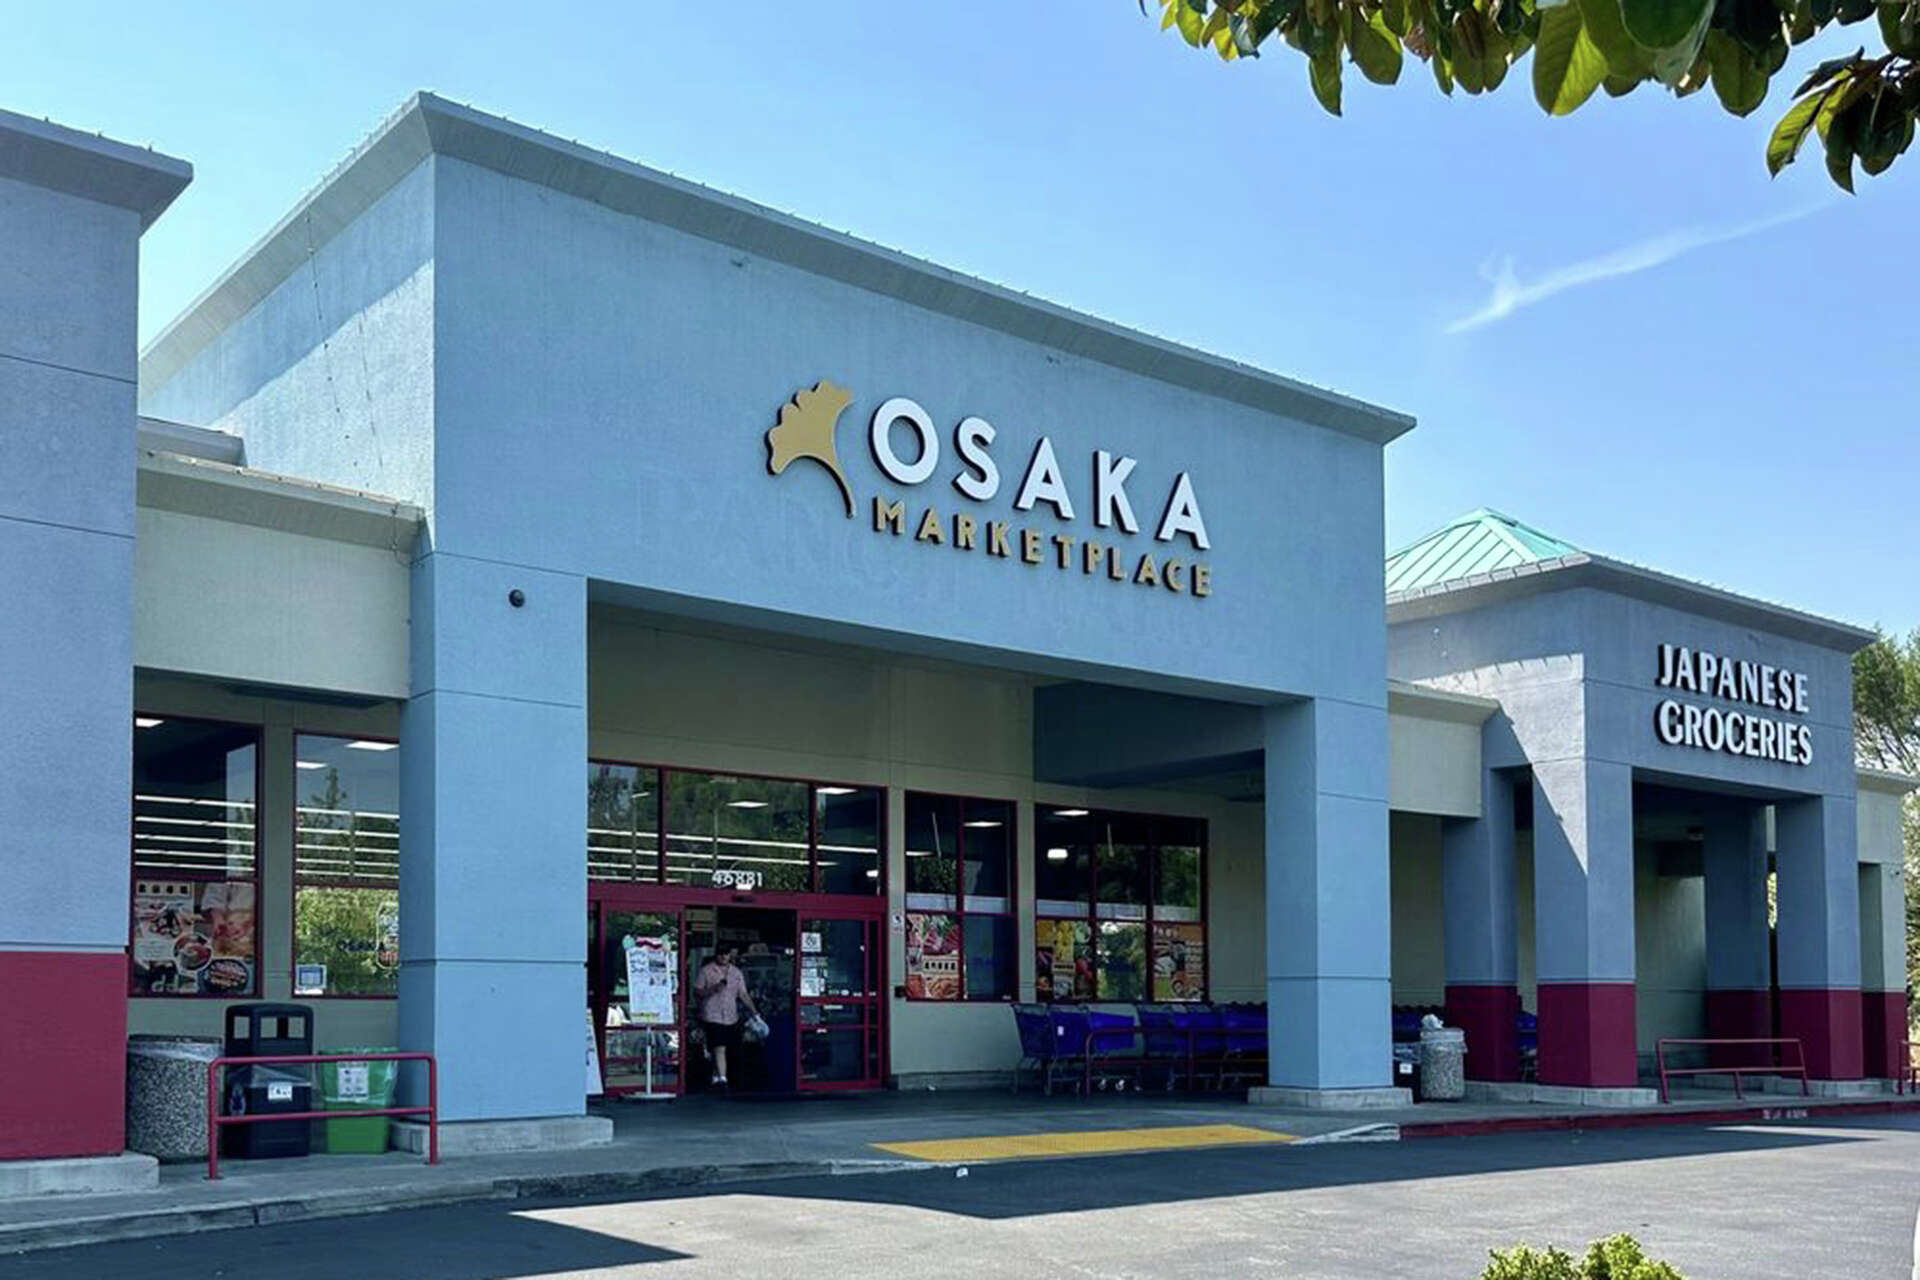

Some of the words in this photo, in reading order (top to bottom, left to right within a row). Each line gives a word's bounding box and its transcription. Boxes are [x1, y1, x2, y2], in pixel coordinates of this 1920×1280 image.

[871, 397, 1211, 550] OSAKA
[874, 496, 1213, 597] MARKETPLACE
[1657, 643, 1809, 712] JAPANESE
[1655, 699, 1813, 766] GROCERIES
